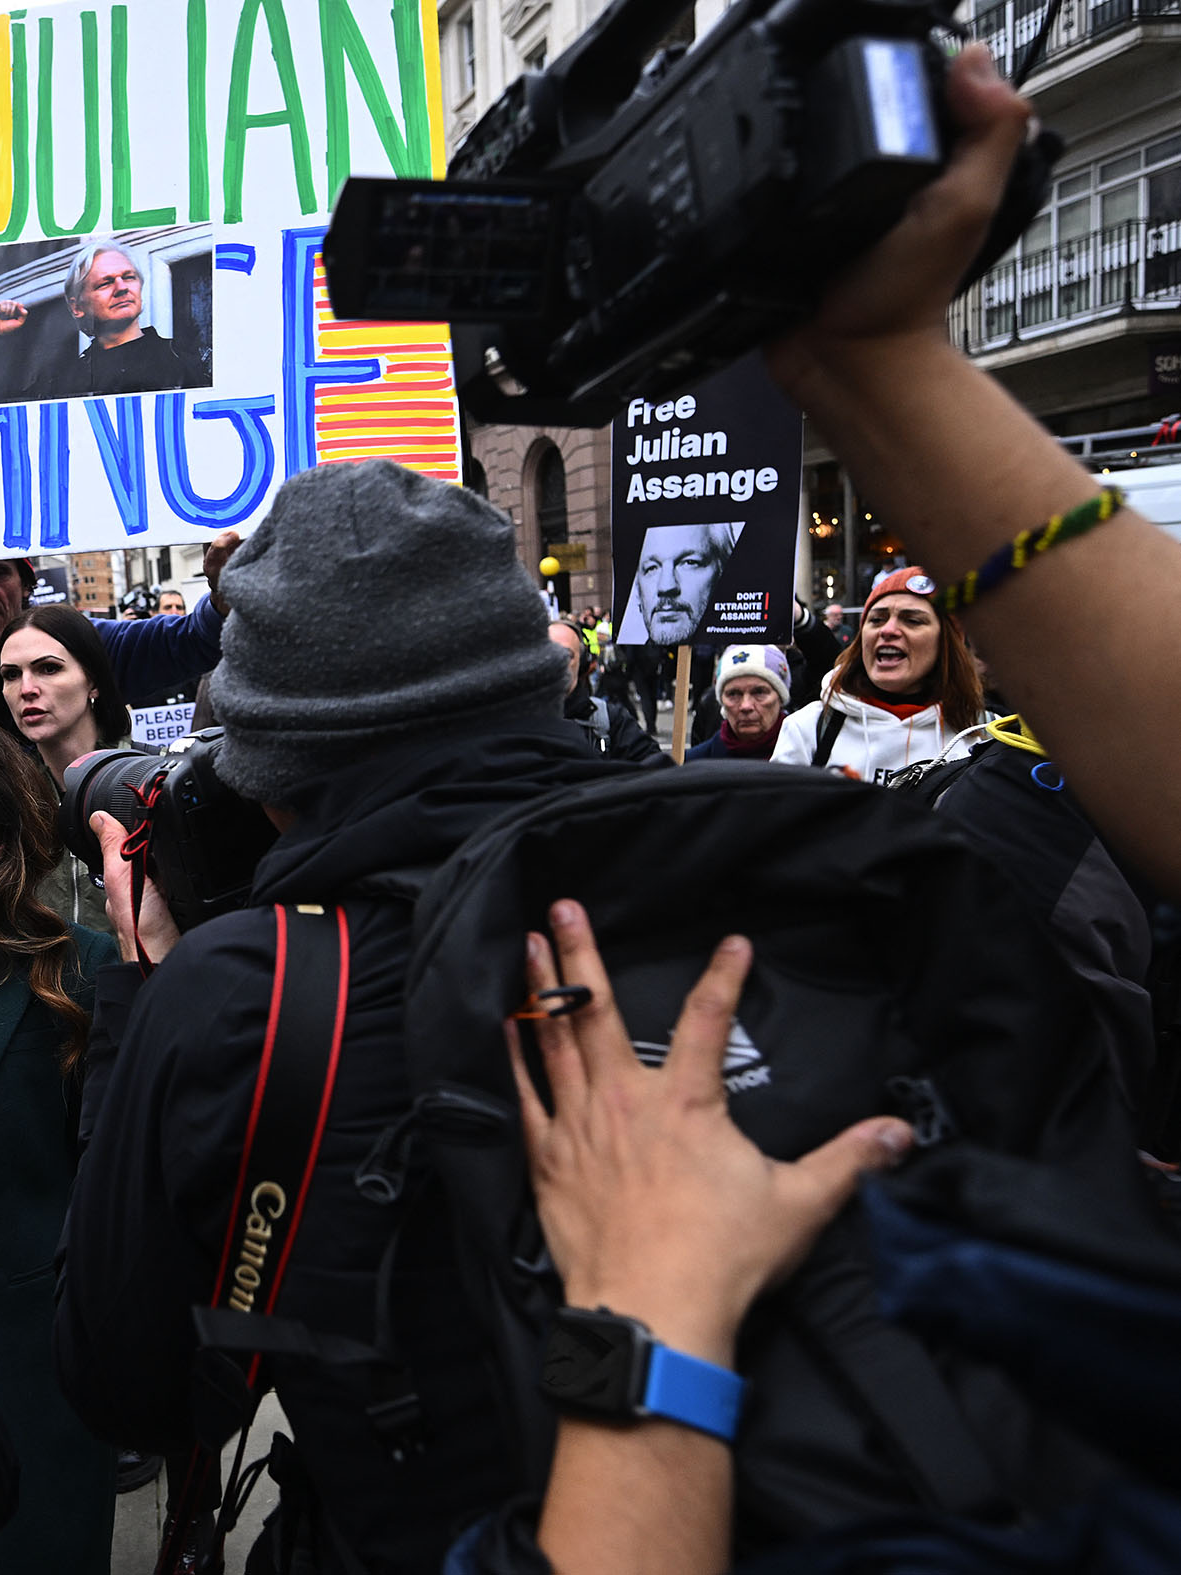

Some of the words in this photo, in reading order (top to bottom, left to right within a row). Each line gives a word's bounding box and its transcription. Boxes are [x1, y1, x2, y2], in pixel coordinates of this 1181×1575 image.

[627, 394, 696, 428] Free
[626, 427, 728, 466] Julian
[626, 466, 779, 504] Assange
[736, 592, 764, 601] DON'T
[714, 602, 763, 611] EXTRADITE
[720, 612, 762, 621] ASSANGE
[706, 626, 767, 635] #FreeAssangeNOW
[134, 707, 194, 727] PLEASE
[146, 725, 186, 741] BEEP
[229, 1180, 287, 1313] Canon
